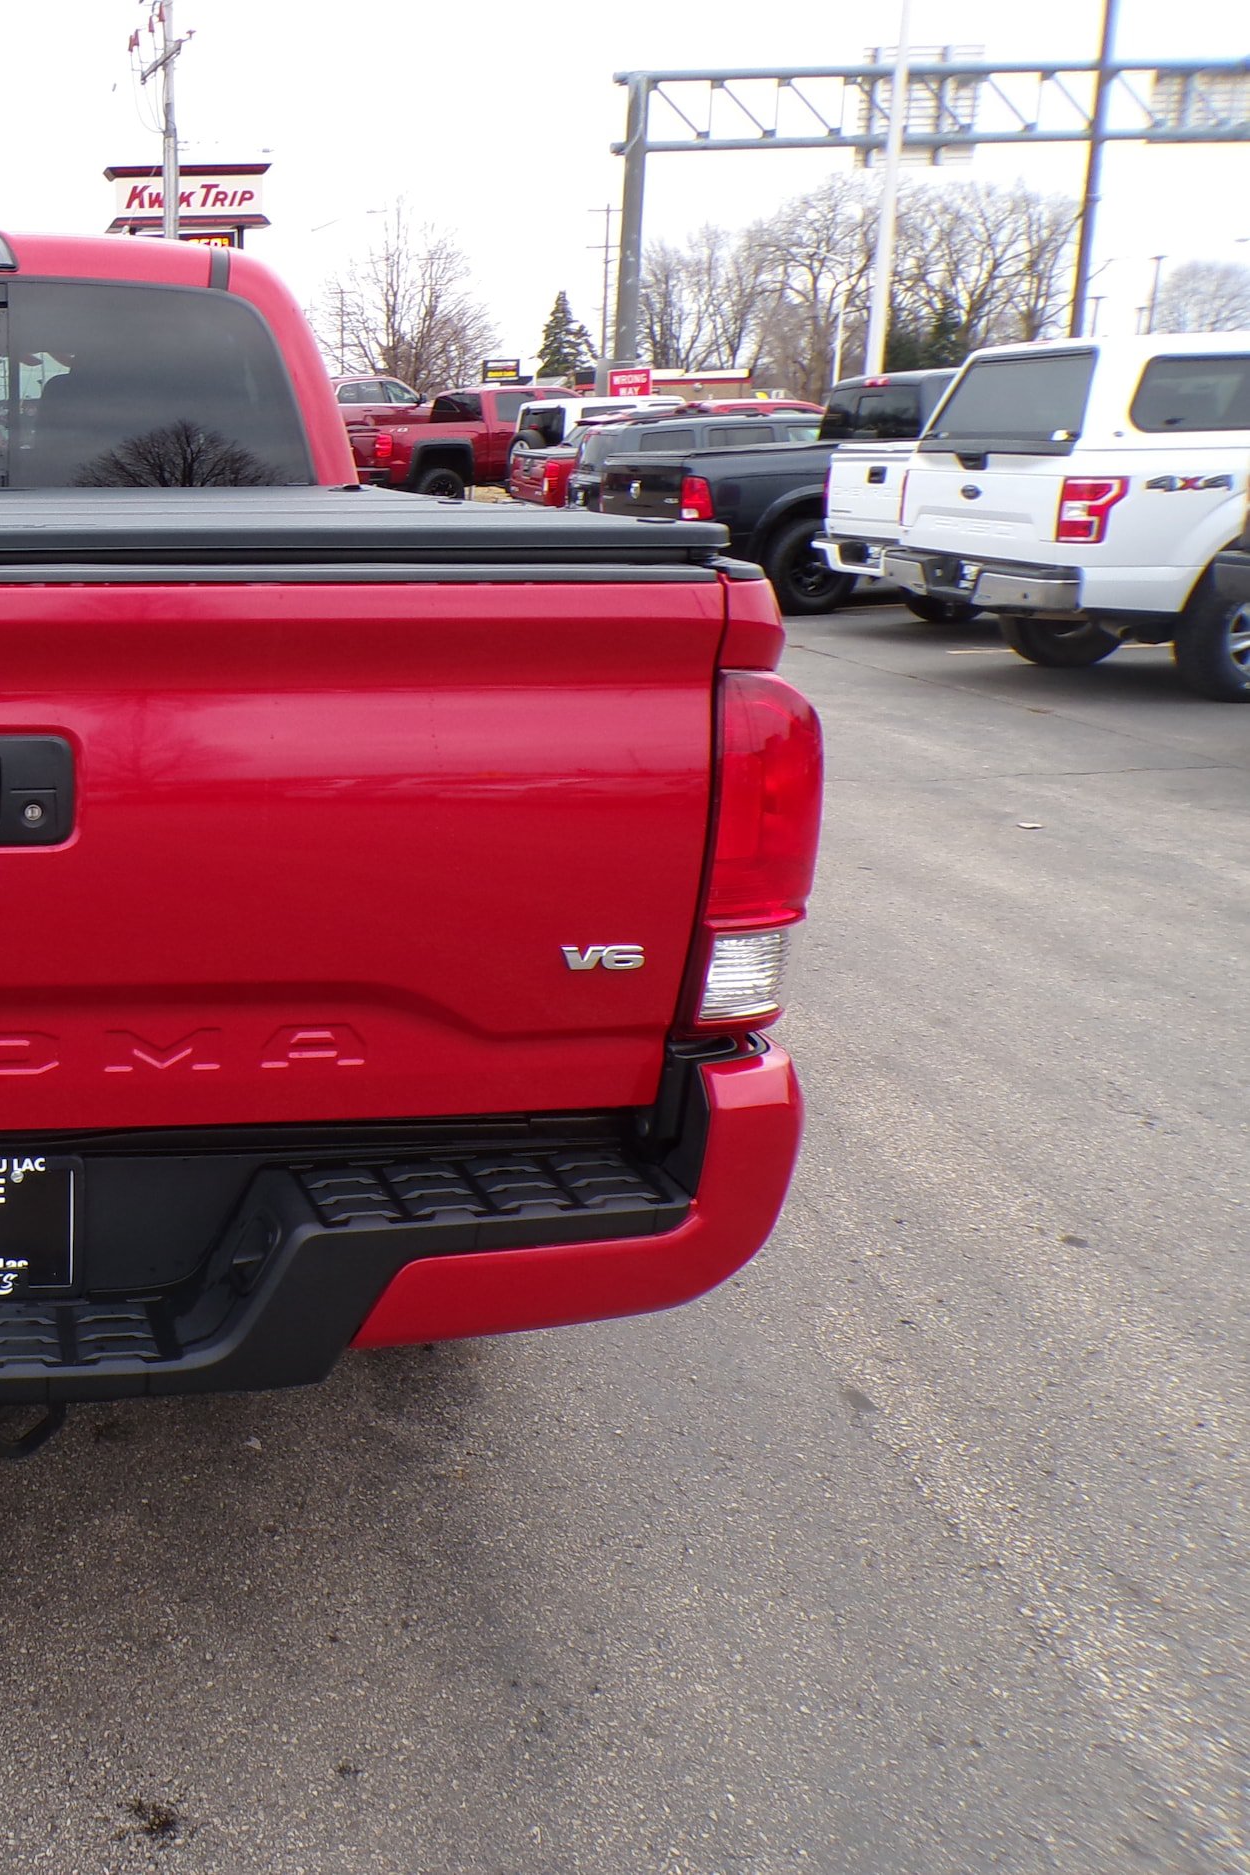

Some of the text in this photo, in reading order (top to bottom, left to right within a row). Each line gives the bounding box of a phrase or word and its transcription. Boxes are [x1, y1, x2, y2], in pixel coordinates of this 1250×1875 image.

[125, 184, 254, 209] KWK TRIP
[613, 373, 647, 385] WRONG
[619, 386, 641, 396] WAY
[561, 945, 645, 970] V6
[13, 1158, 46, 1172] LAC
